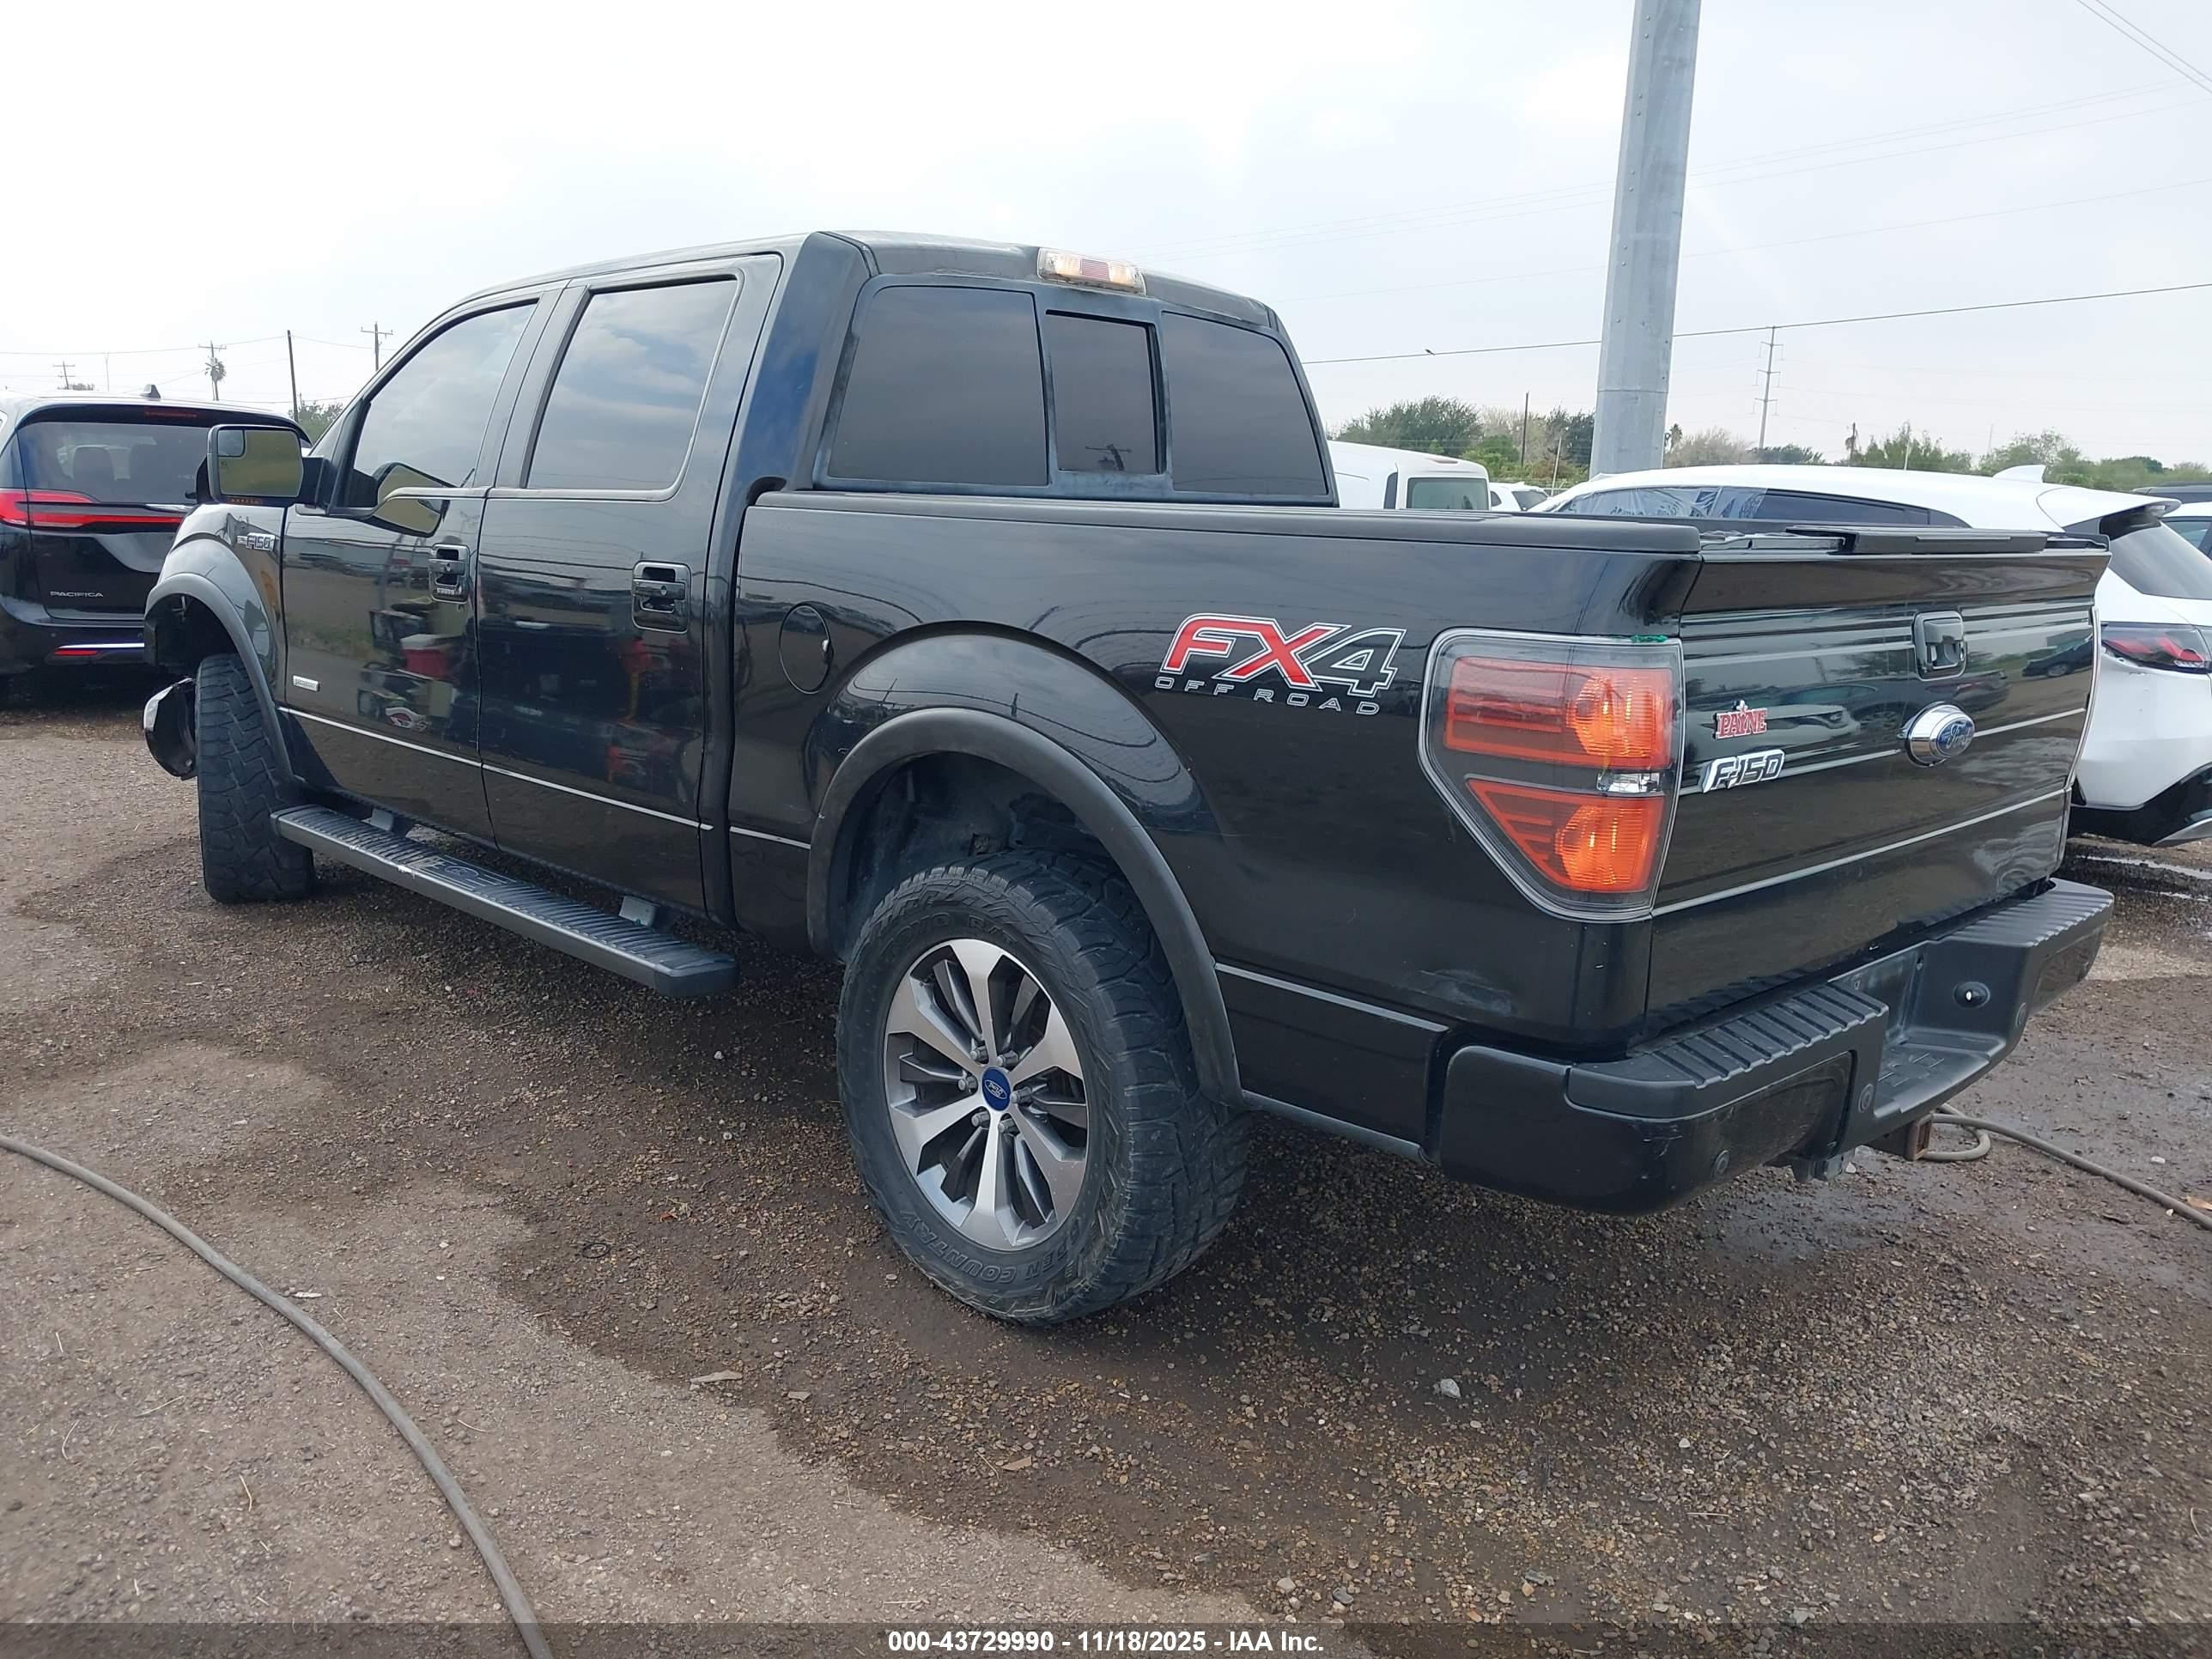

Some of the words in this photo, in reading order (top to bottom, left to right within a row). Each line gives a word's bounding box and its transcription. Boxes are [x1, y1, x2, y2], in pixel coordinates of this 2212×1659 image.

[1159, 613, 1407, 698] FX4
[1155, 676, 1235, 696] OFF
[1254, 689, 1380, 714] ROAD
[1717, 707, 1768, 739] PAYNE
[900, 1209, 1018, 1285] COUNTRY
